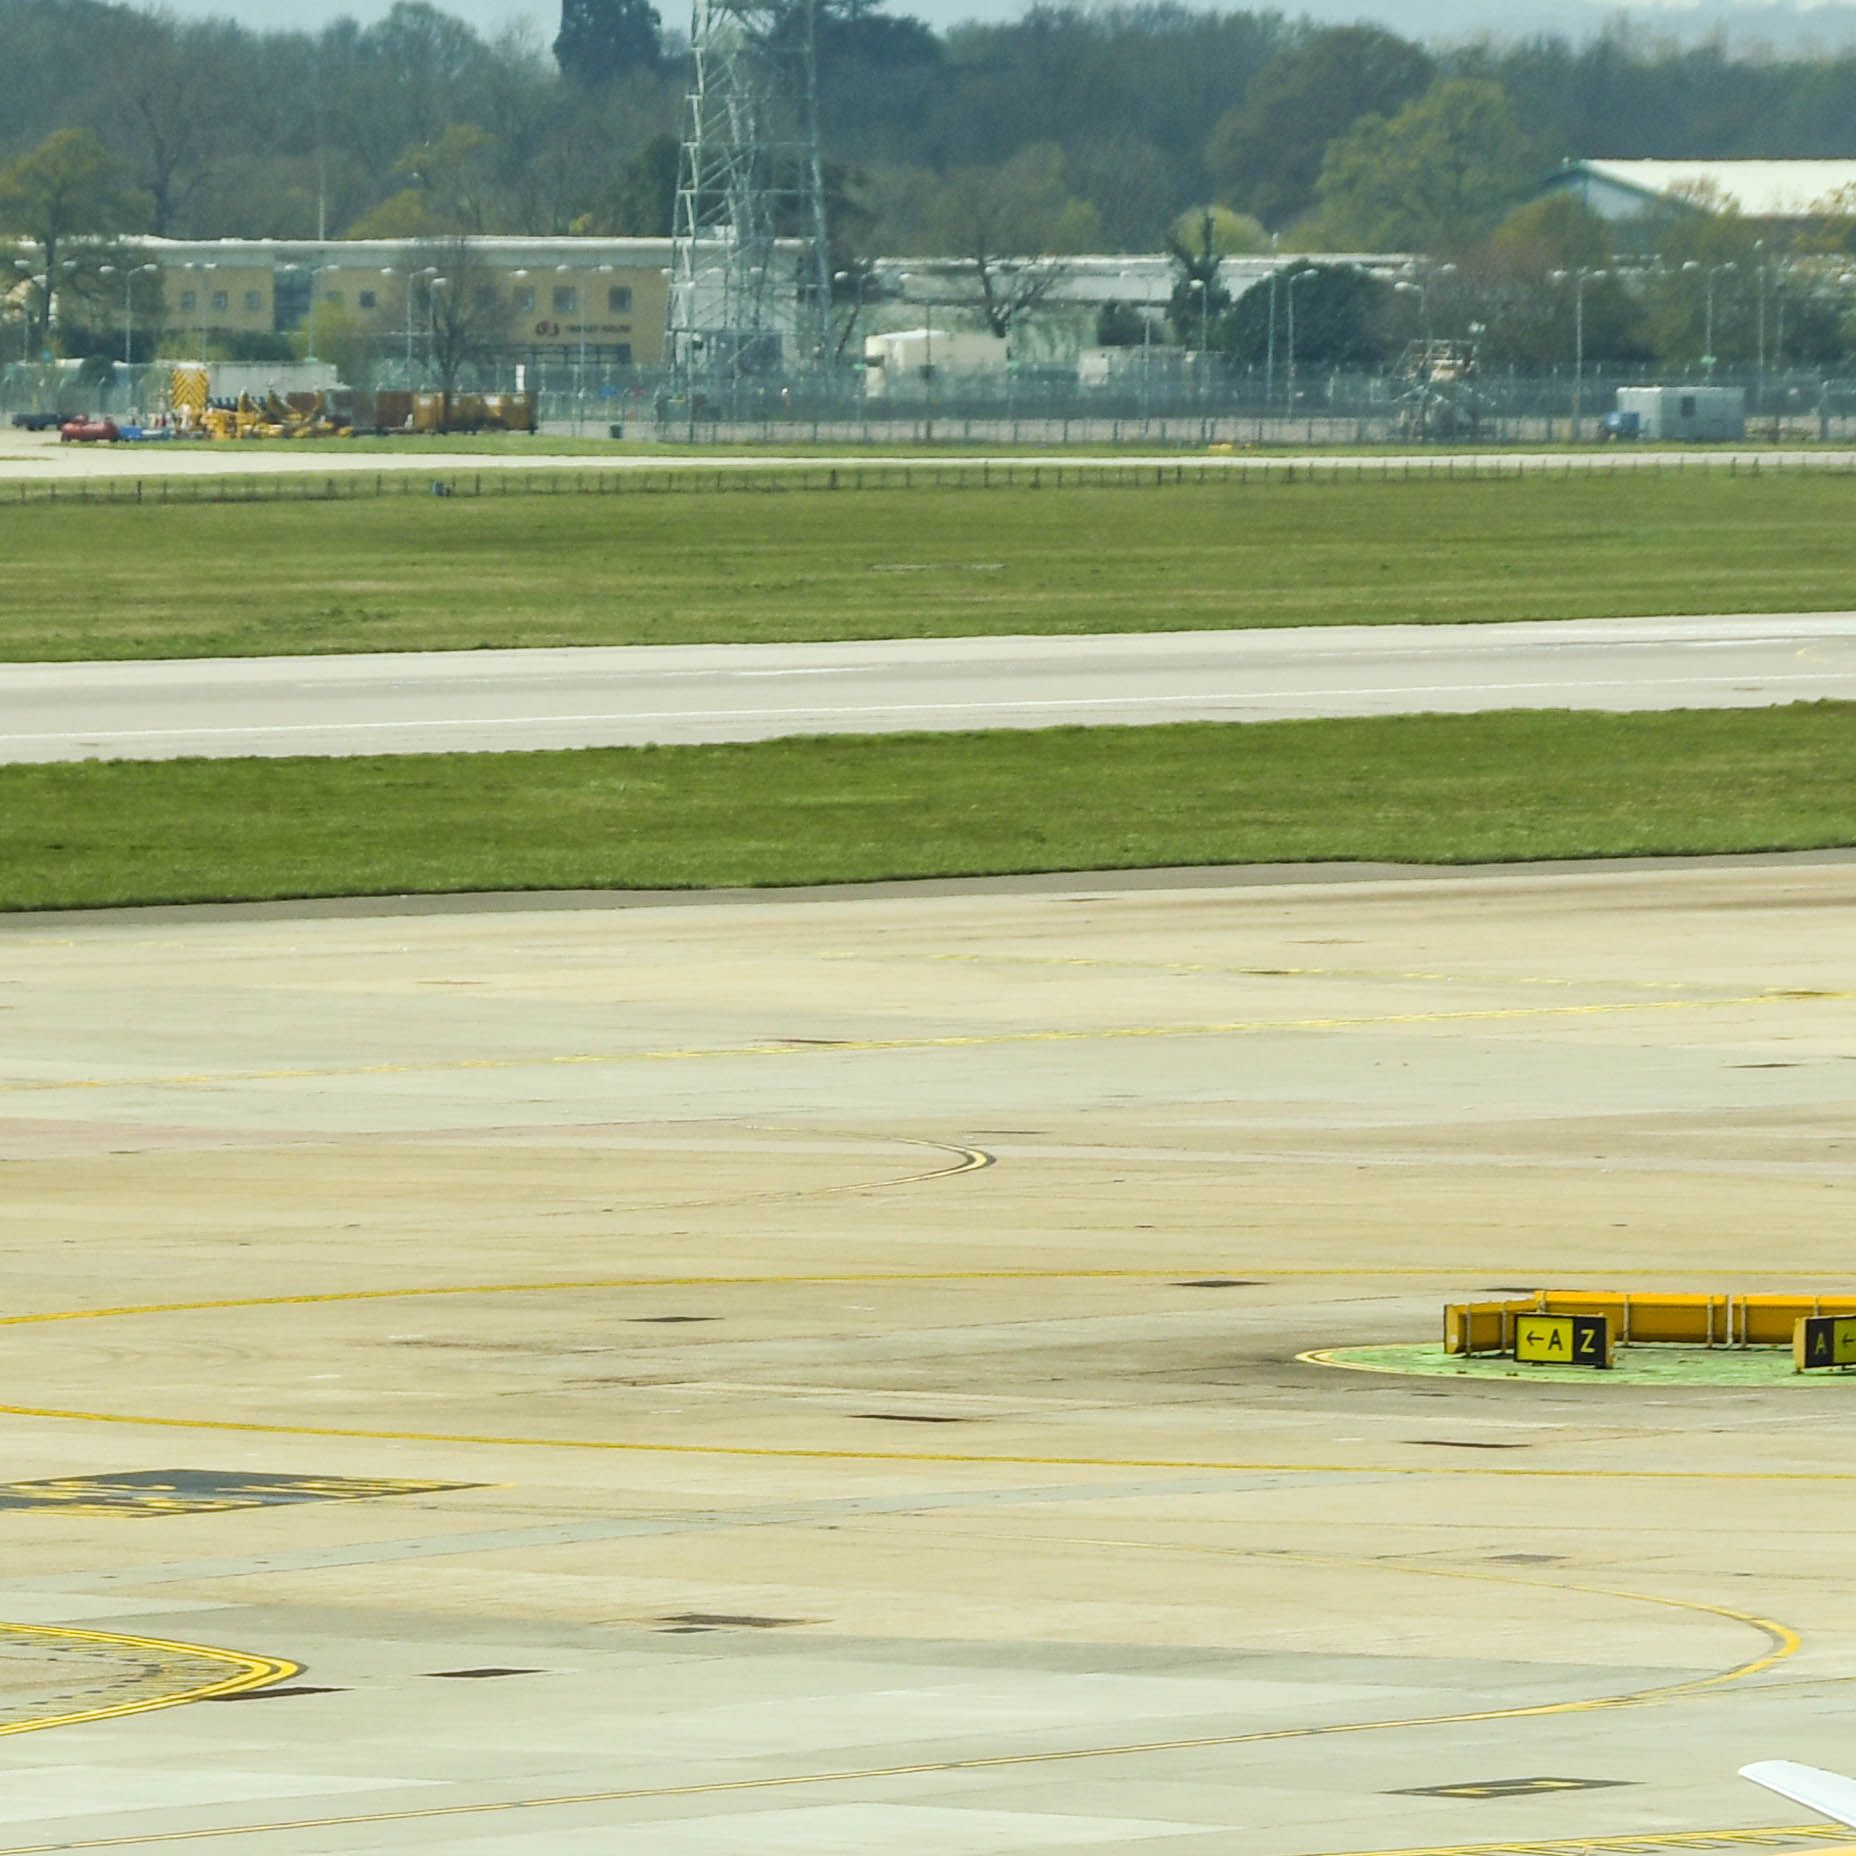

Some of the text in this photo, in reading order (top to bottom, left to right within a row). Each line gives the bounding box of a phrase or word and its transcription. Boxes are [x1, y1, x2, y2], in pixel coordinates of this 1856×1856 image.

[1547, 1327, 1595, 1354] A Z
[1813, 1331, 1827, 1355] A
